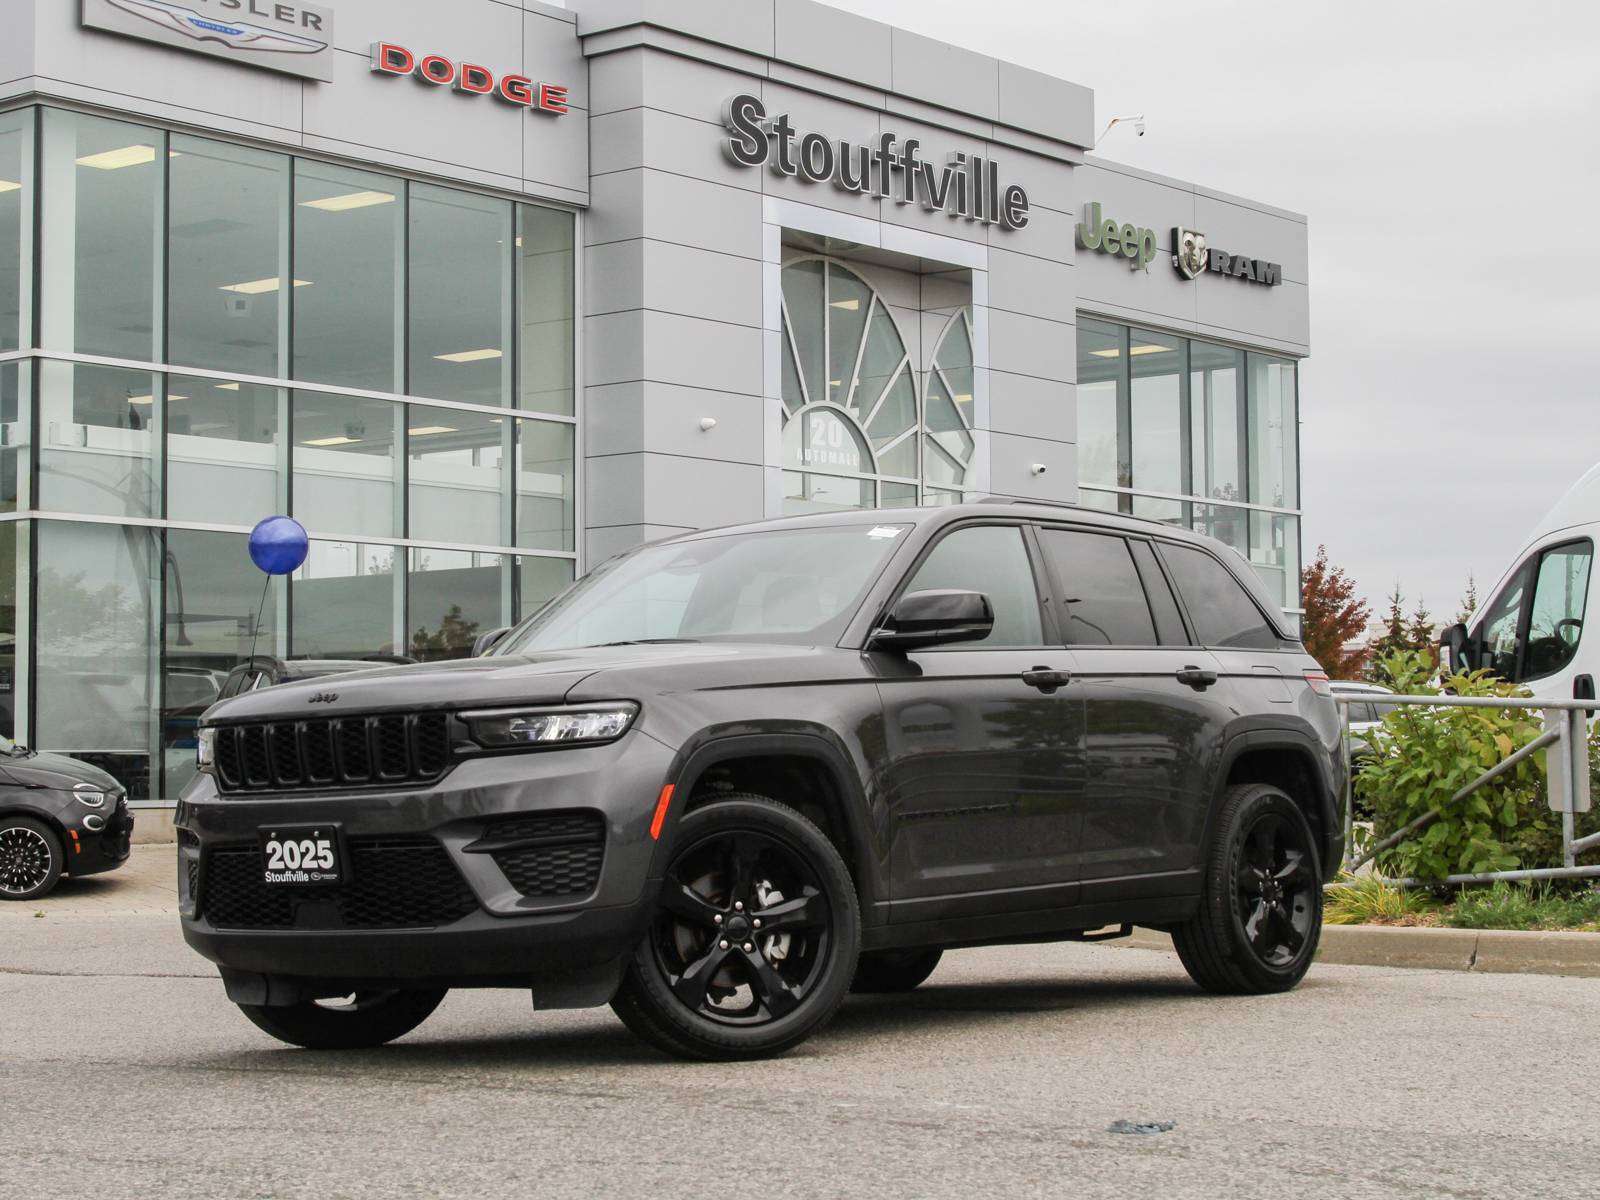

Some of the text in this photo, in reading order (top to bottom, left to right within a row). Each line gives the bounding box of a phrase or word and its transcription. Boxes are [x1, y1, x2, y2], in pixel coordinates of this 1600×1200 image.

[371, 41, 569, 117] DODGE
[724, 93, 1030, 231] Stouffville
[1076, 201, 1157, 270] Jeep
[1207, 248, 1282, 286] RAM
[811, 416, 843, 449] 20
[266, 839, 334, 870] 2025
[265, 870, 309, 883] Stouffville
